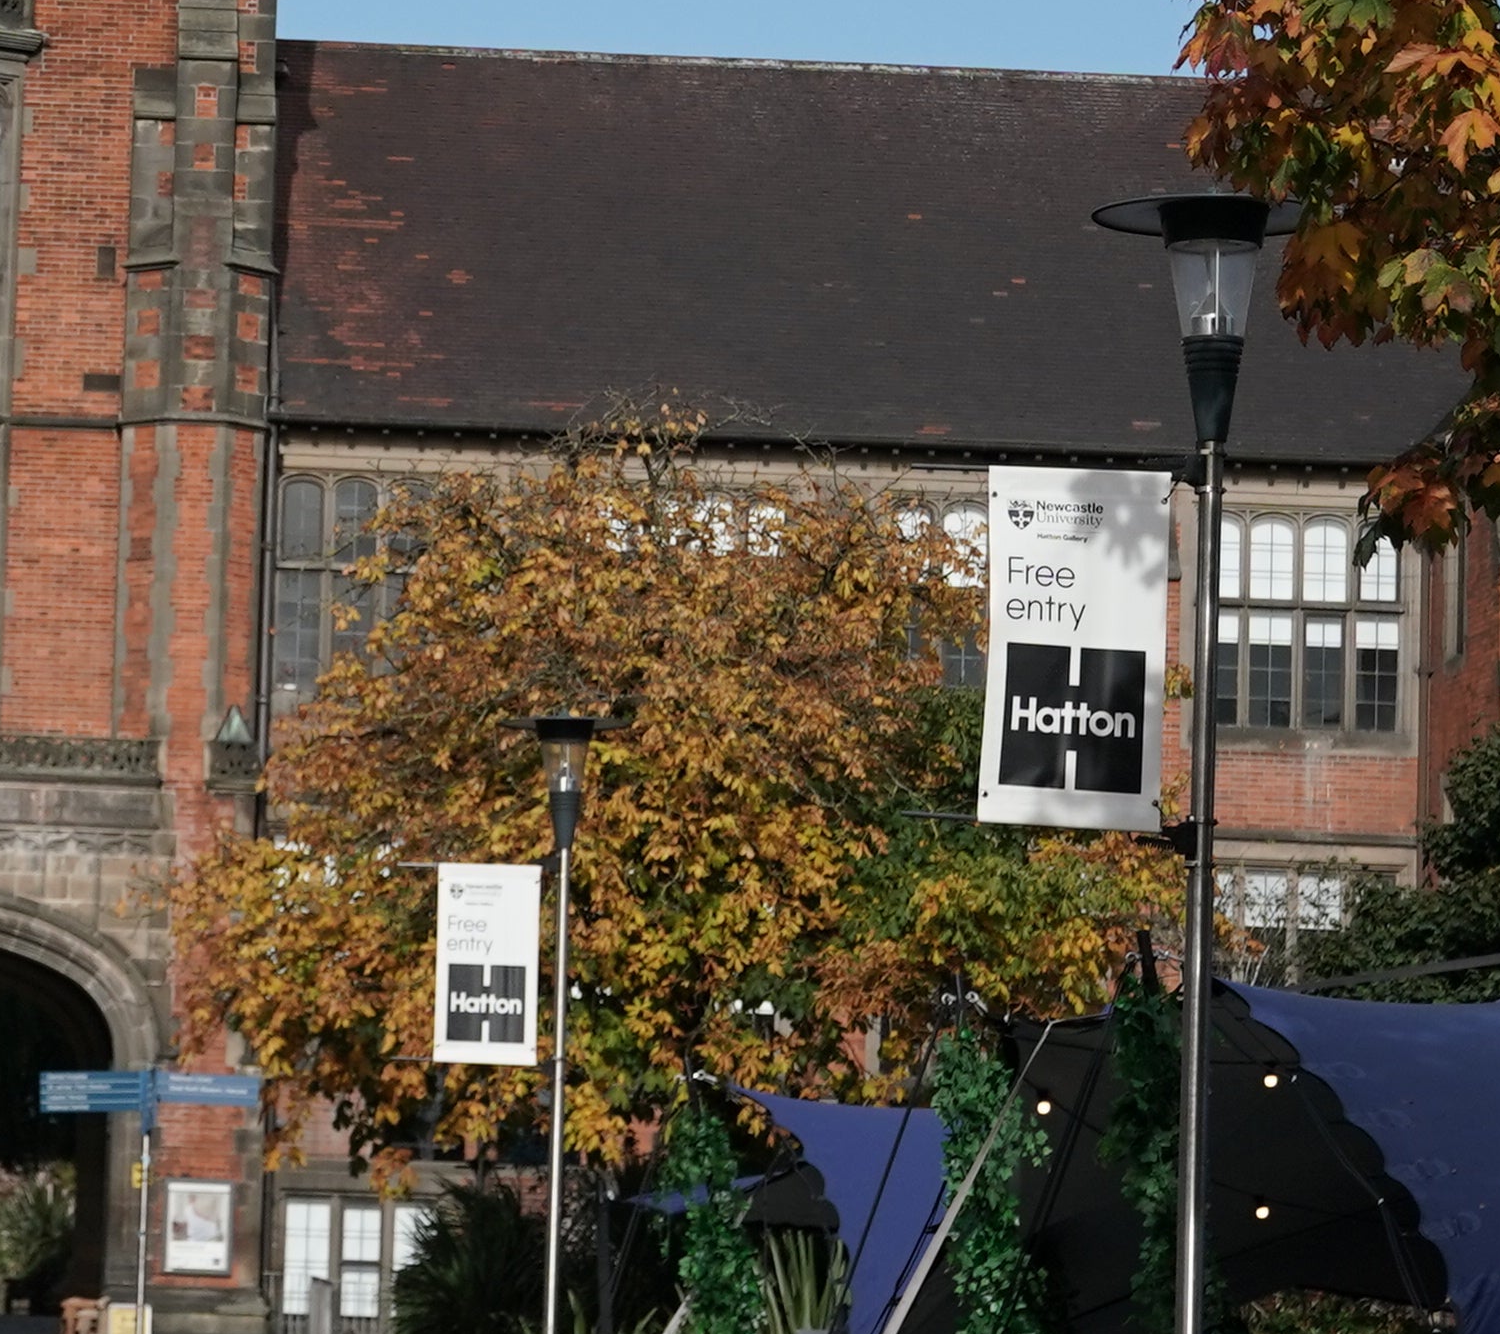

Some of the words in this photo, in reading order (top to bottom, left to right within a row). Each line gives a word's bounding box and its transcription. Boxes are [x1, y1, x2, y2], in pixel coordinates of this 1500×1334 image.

[1036, 500, 1104, 514] Newcastle
[1036, 511, 1104, 529] University
[1036, 532, 1062, 541] Hatton
[1062, 533, 1088, 544] Gallery
[1008, 556, 1076, 589] Free
[1006, 596, 1087, 632] entry
[1010, 695, 1136, 739] Hatton
[447, 915, 487, 933] Free
[446, 936, 493, 955] entry
[450, 991, 523, 1015] Hatton
